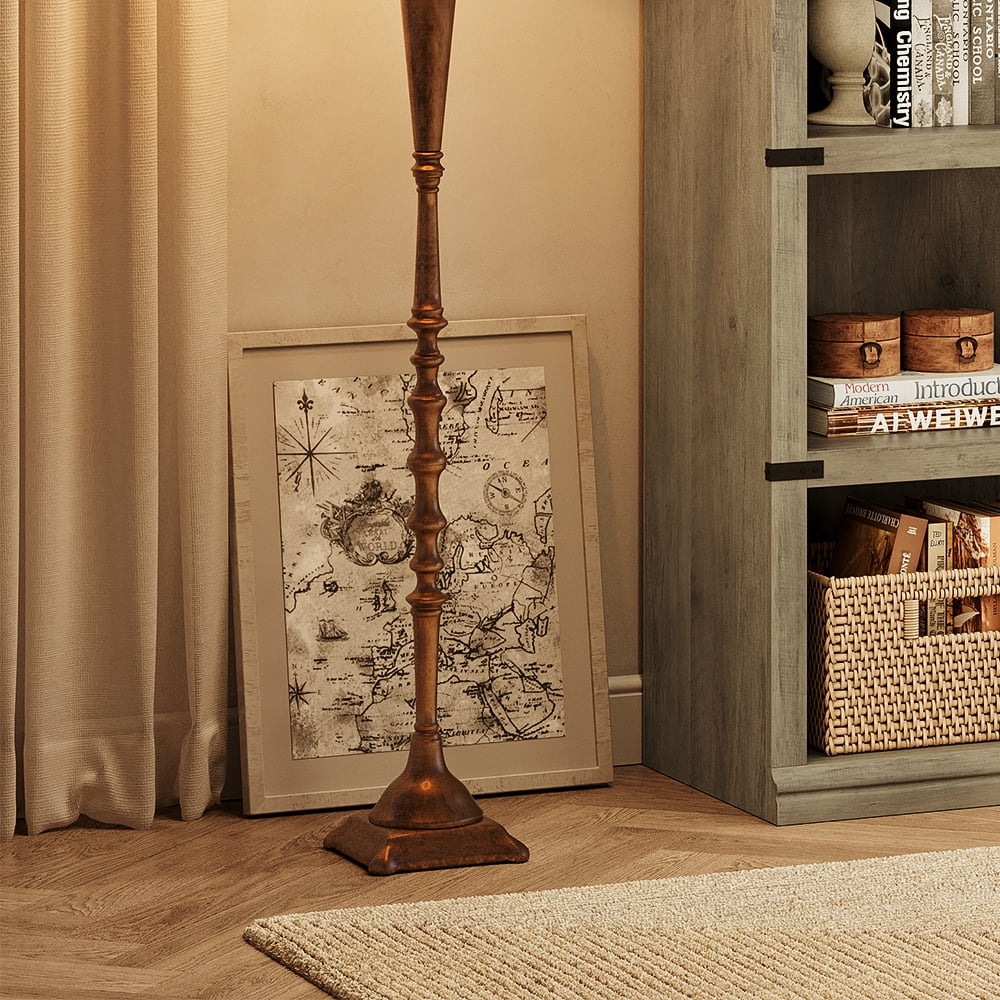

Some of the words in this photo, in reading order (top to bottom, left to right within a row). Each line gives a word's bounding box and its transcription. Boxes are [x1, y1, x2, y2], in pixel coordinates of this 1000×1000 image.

[972, 26, 982, 85] SCHOOL
[893, 30, 912, 127] Chemistry
[845, 382, 890, 394] Modern
[840, 393, 898, 407] American
[870, 413, 899, 433] AI
[867, 509, 900, 528] CHARLOTTE
[358, 540, 397, 552] WORLD
